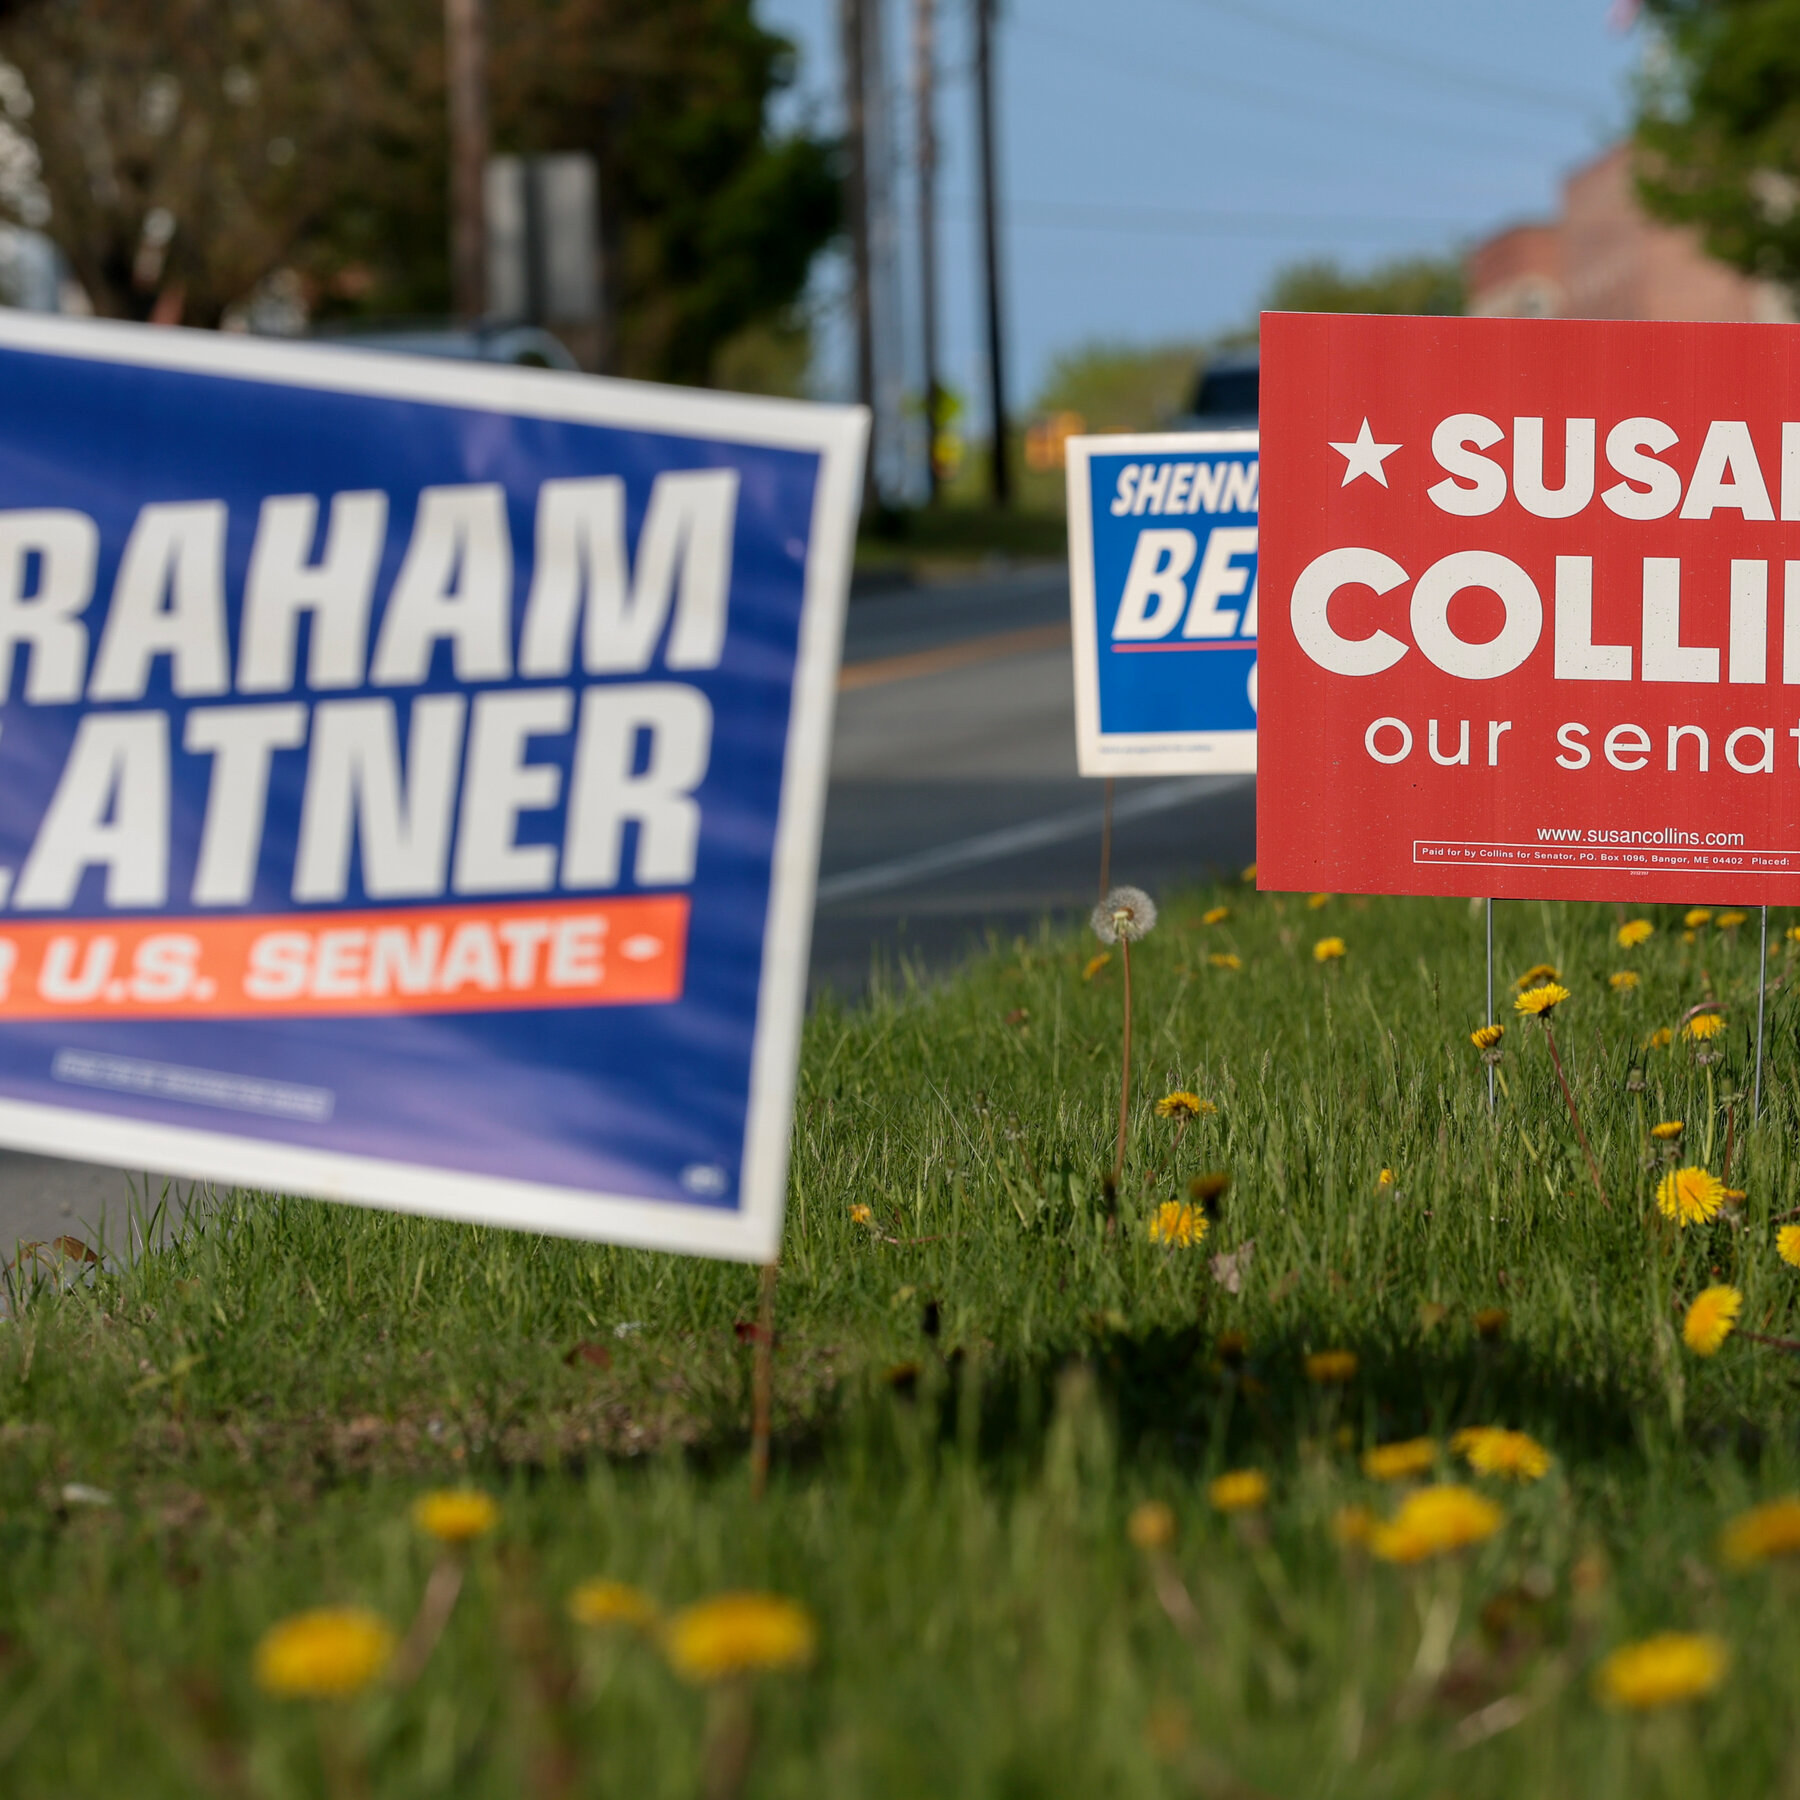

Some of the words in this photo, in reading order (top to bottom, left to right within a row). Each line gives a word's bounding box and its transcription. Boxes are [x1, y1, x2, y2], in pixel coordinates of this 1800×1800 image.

[1110, 461, 1259, 517] SHENN
[1427, 413, 1800, 521] SUSA
[1111, 526, 1258, 640] BE
[1290, 547, 1800, 685] COLLI
[1364, 716, 1511, 766] our
[0, 681, 715, 911] ATNER
[1536, 828, 1744, 847] www.susancollins.com
[1422, 848, 1444, 856] Paid
[1447, 848, 1461, 856] for
[1464, 849, 1477, 858] by
[1479, 849, 1514, 858] Collins
[1517, 851, 1531, 859] for
[1534, 851, 1576, 860] Senator,
[1579, 853, 1597, 861] PO.
[1600, 853, 1619, 861] Box
[1622, 854, 1648, 862] 1096,
[1651, 854, 1690, 864] Bangor,
[1693, 856, 1710, 864] ME
[1712, 857, 1743, 865] 04402
[1751, 857, 1790, 866] Placed:
[38, 935, 216, 1004] U.S.
[244, 915, 609, 999] SENATE
